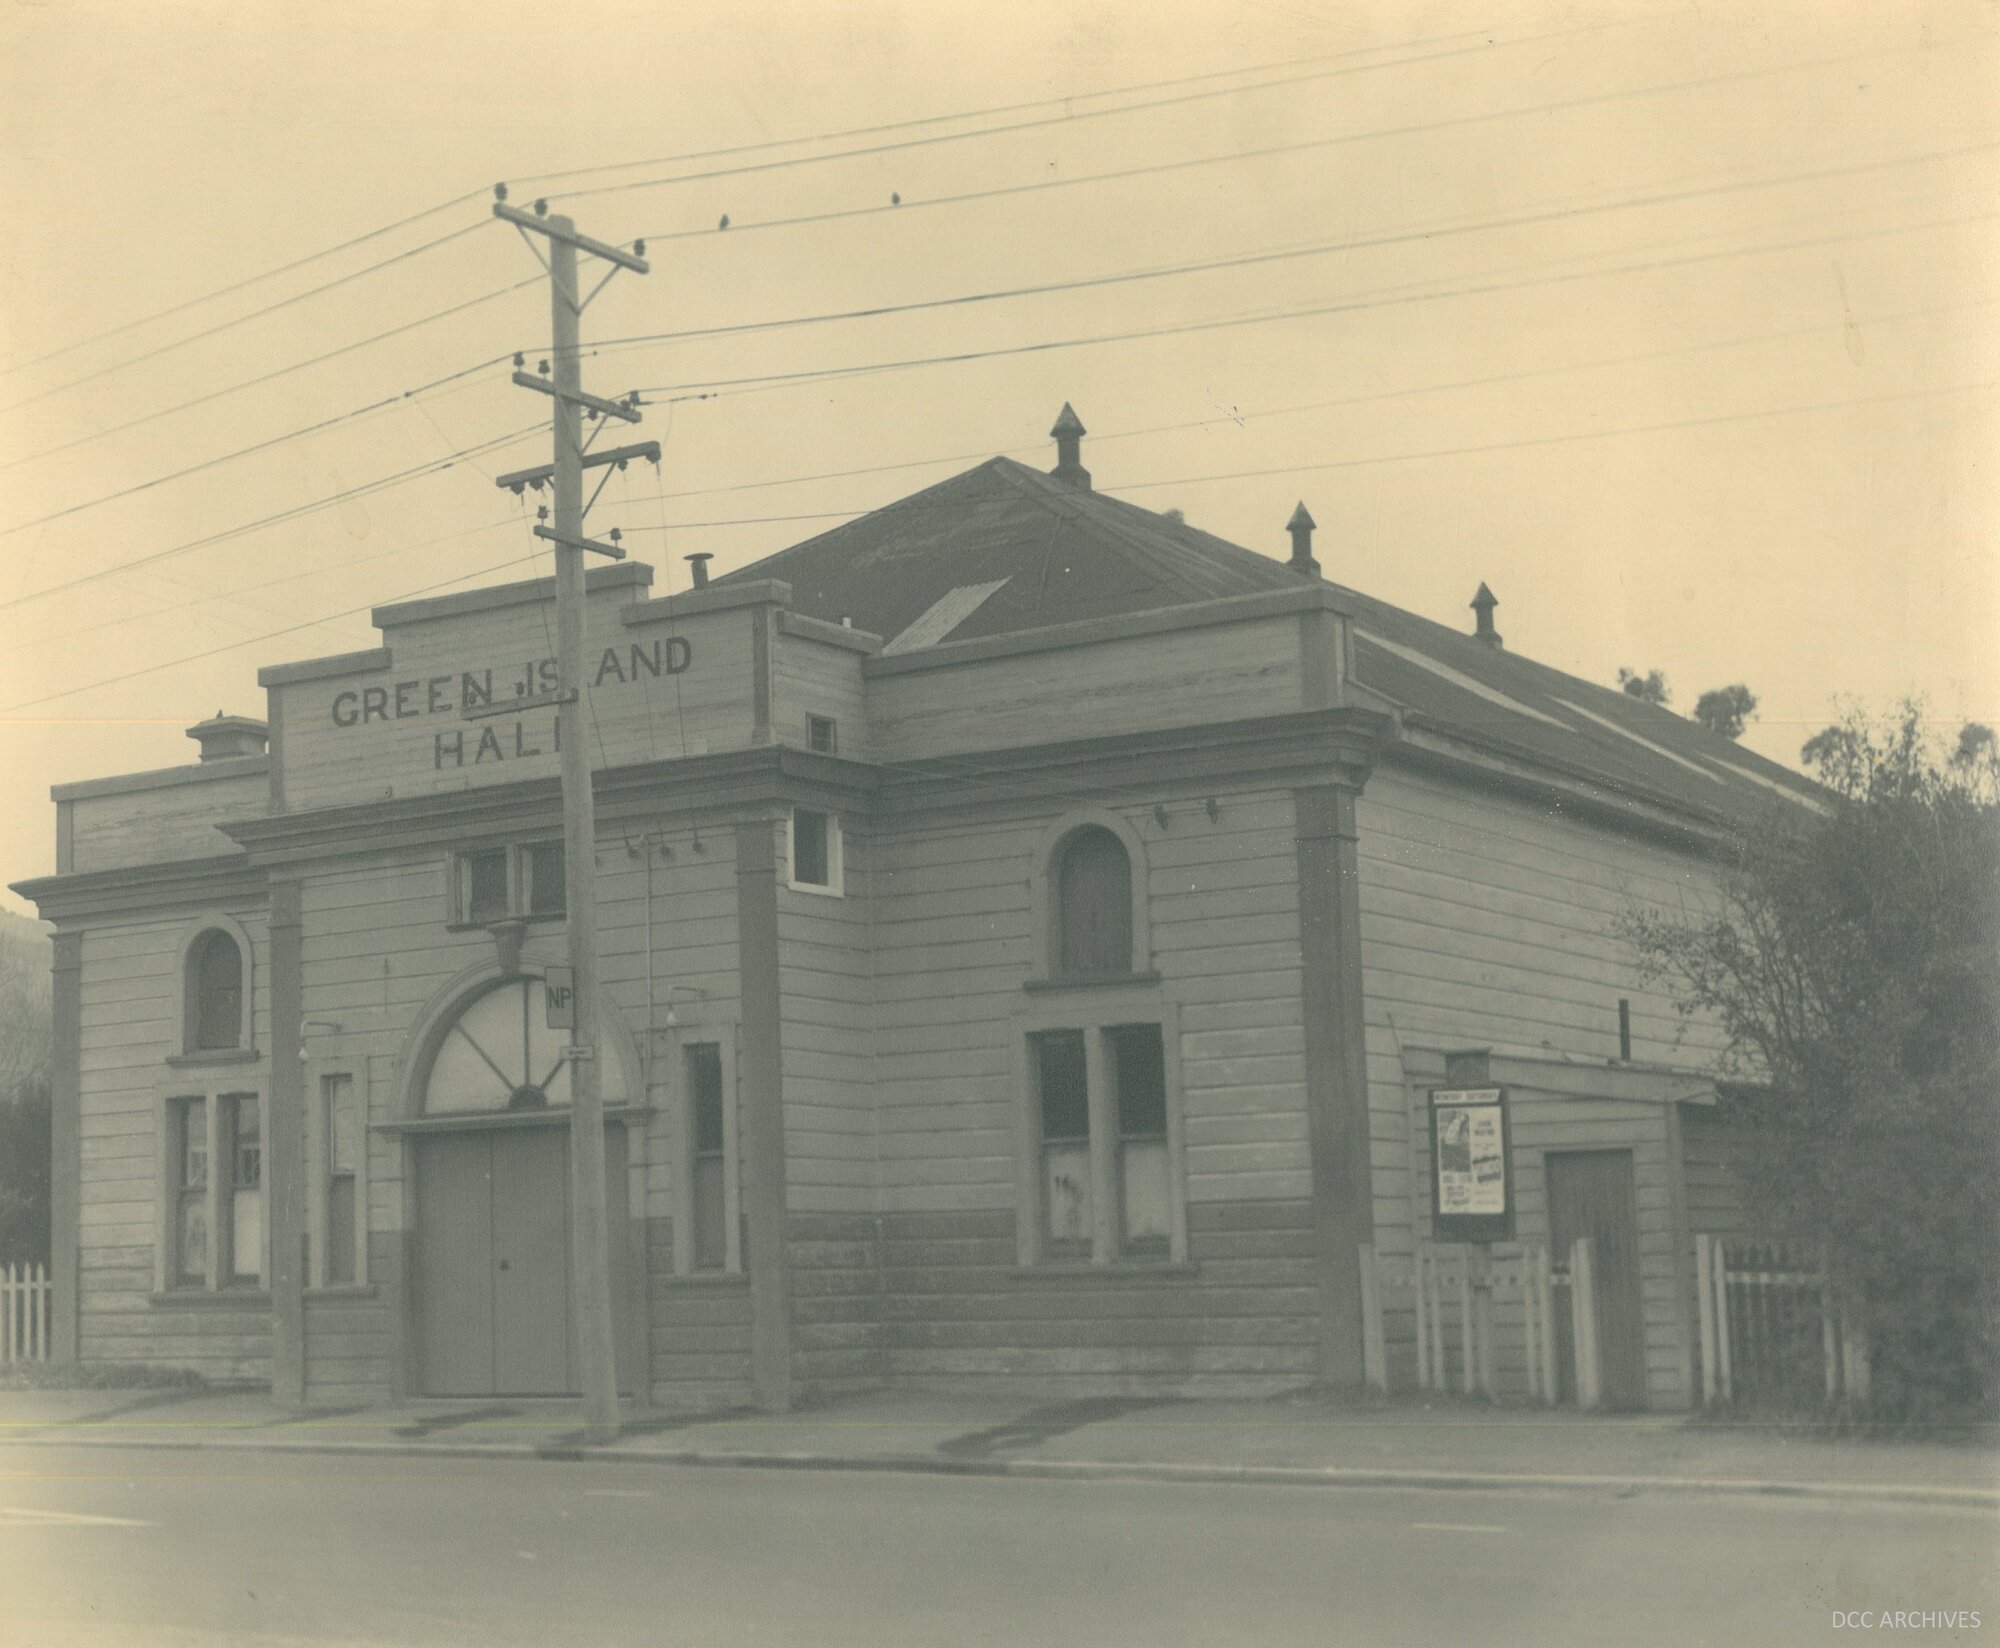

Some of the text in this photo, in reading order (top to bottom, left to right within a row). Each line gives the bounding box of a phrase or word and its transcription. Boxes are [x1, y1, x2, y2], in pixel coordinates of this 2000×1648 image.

[332, 636, 692, 727] GREEN ISAND
[548, 987, 572, 1009] NP
